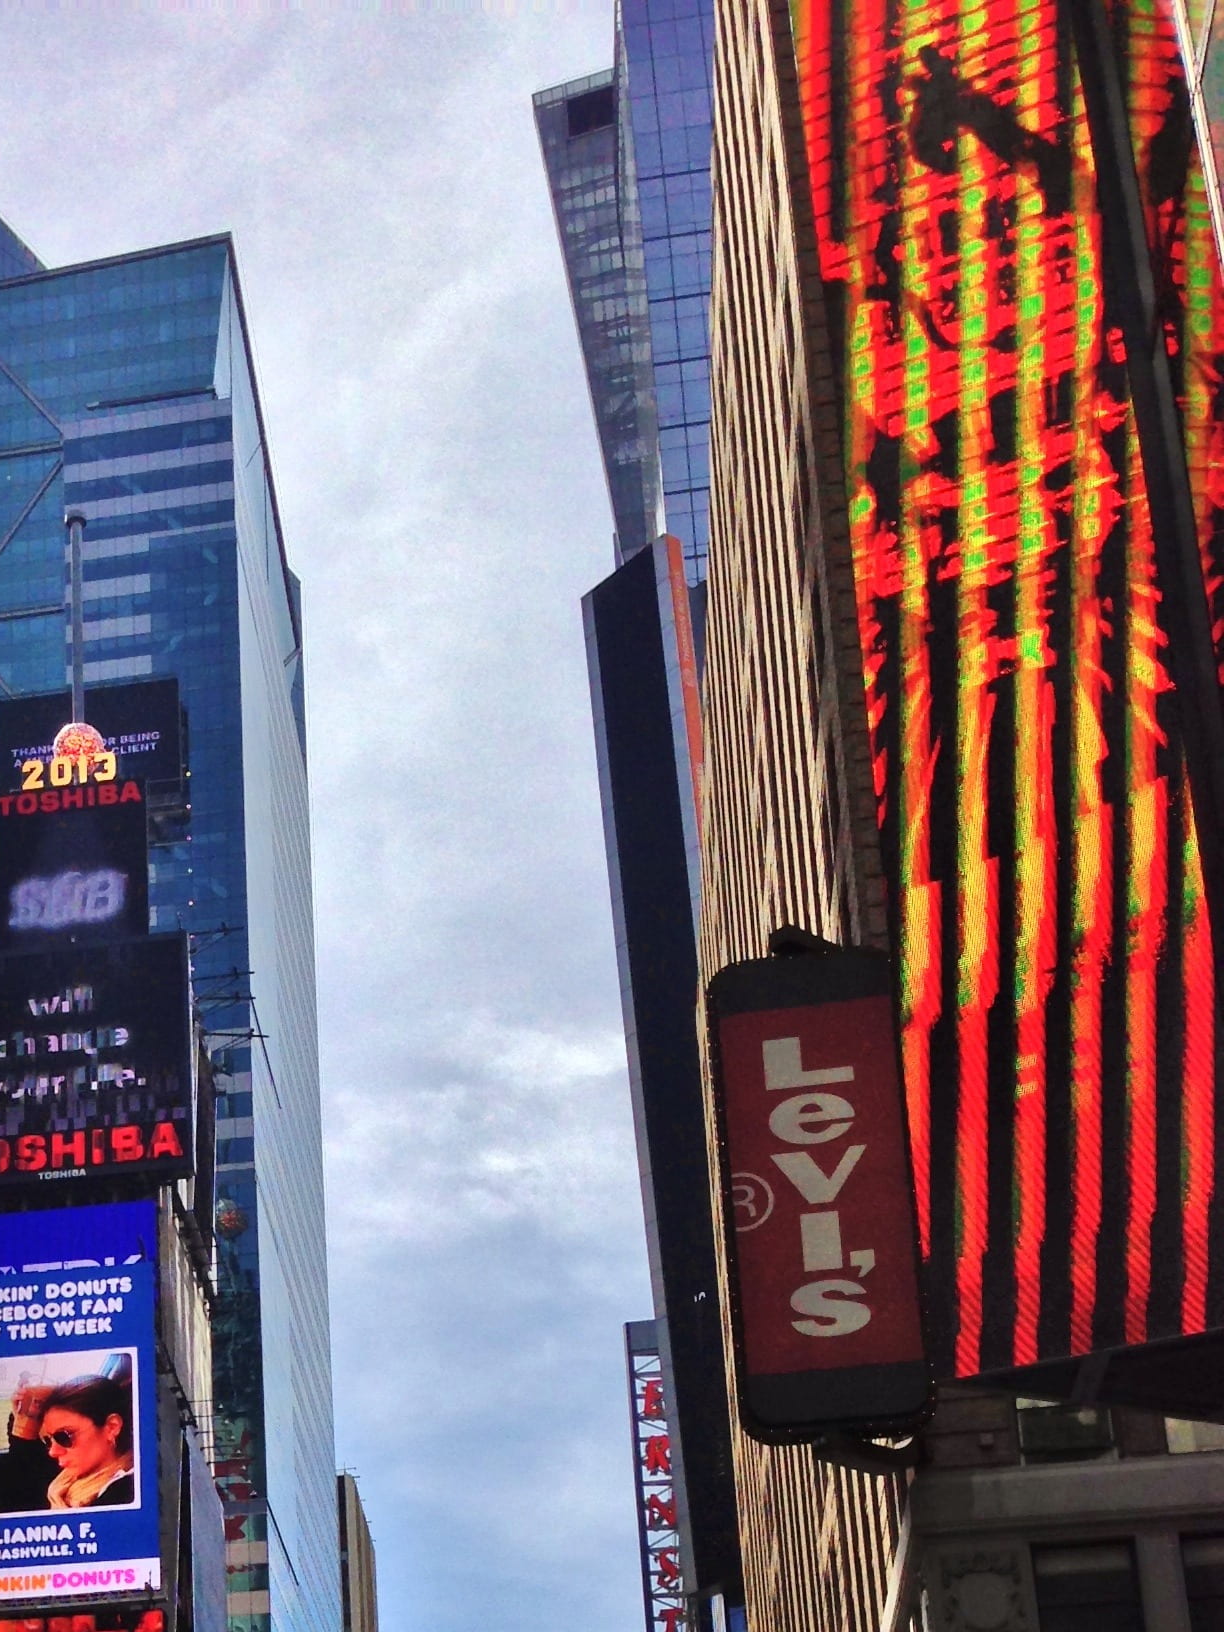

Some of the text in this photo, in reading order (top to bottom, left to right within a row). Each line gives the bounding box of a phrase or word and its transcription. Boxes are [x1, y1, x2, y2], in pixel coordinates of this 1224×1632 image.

[120, 731, 160, 744] BEING
[111, 742, 157, 755] CLIENT
[22, 752, 116, 790] 2013
[38, 1168, 86, 1180] TOSHIBA
[45, 1276, 133, 1299] DONUTS
[81, 1297, 123, 1316] FAN
[7, 1322, 48, 1340] THE
[52, 1316, 113, 1337] WEEK
[80, 1521, 95, 1539] F.
[77, 1541, 97, 1555] TN
[51, 1567, 136, 1589] DONUTS
